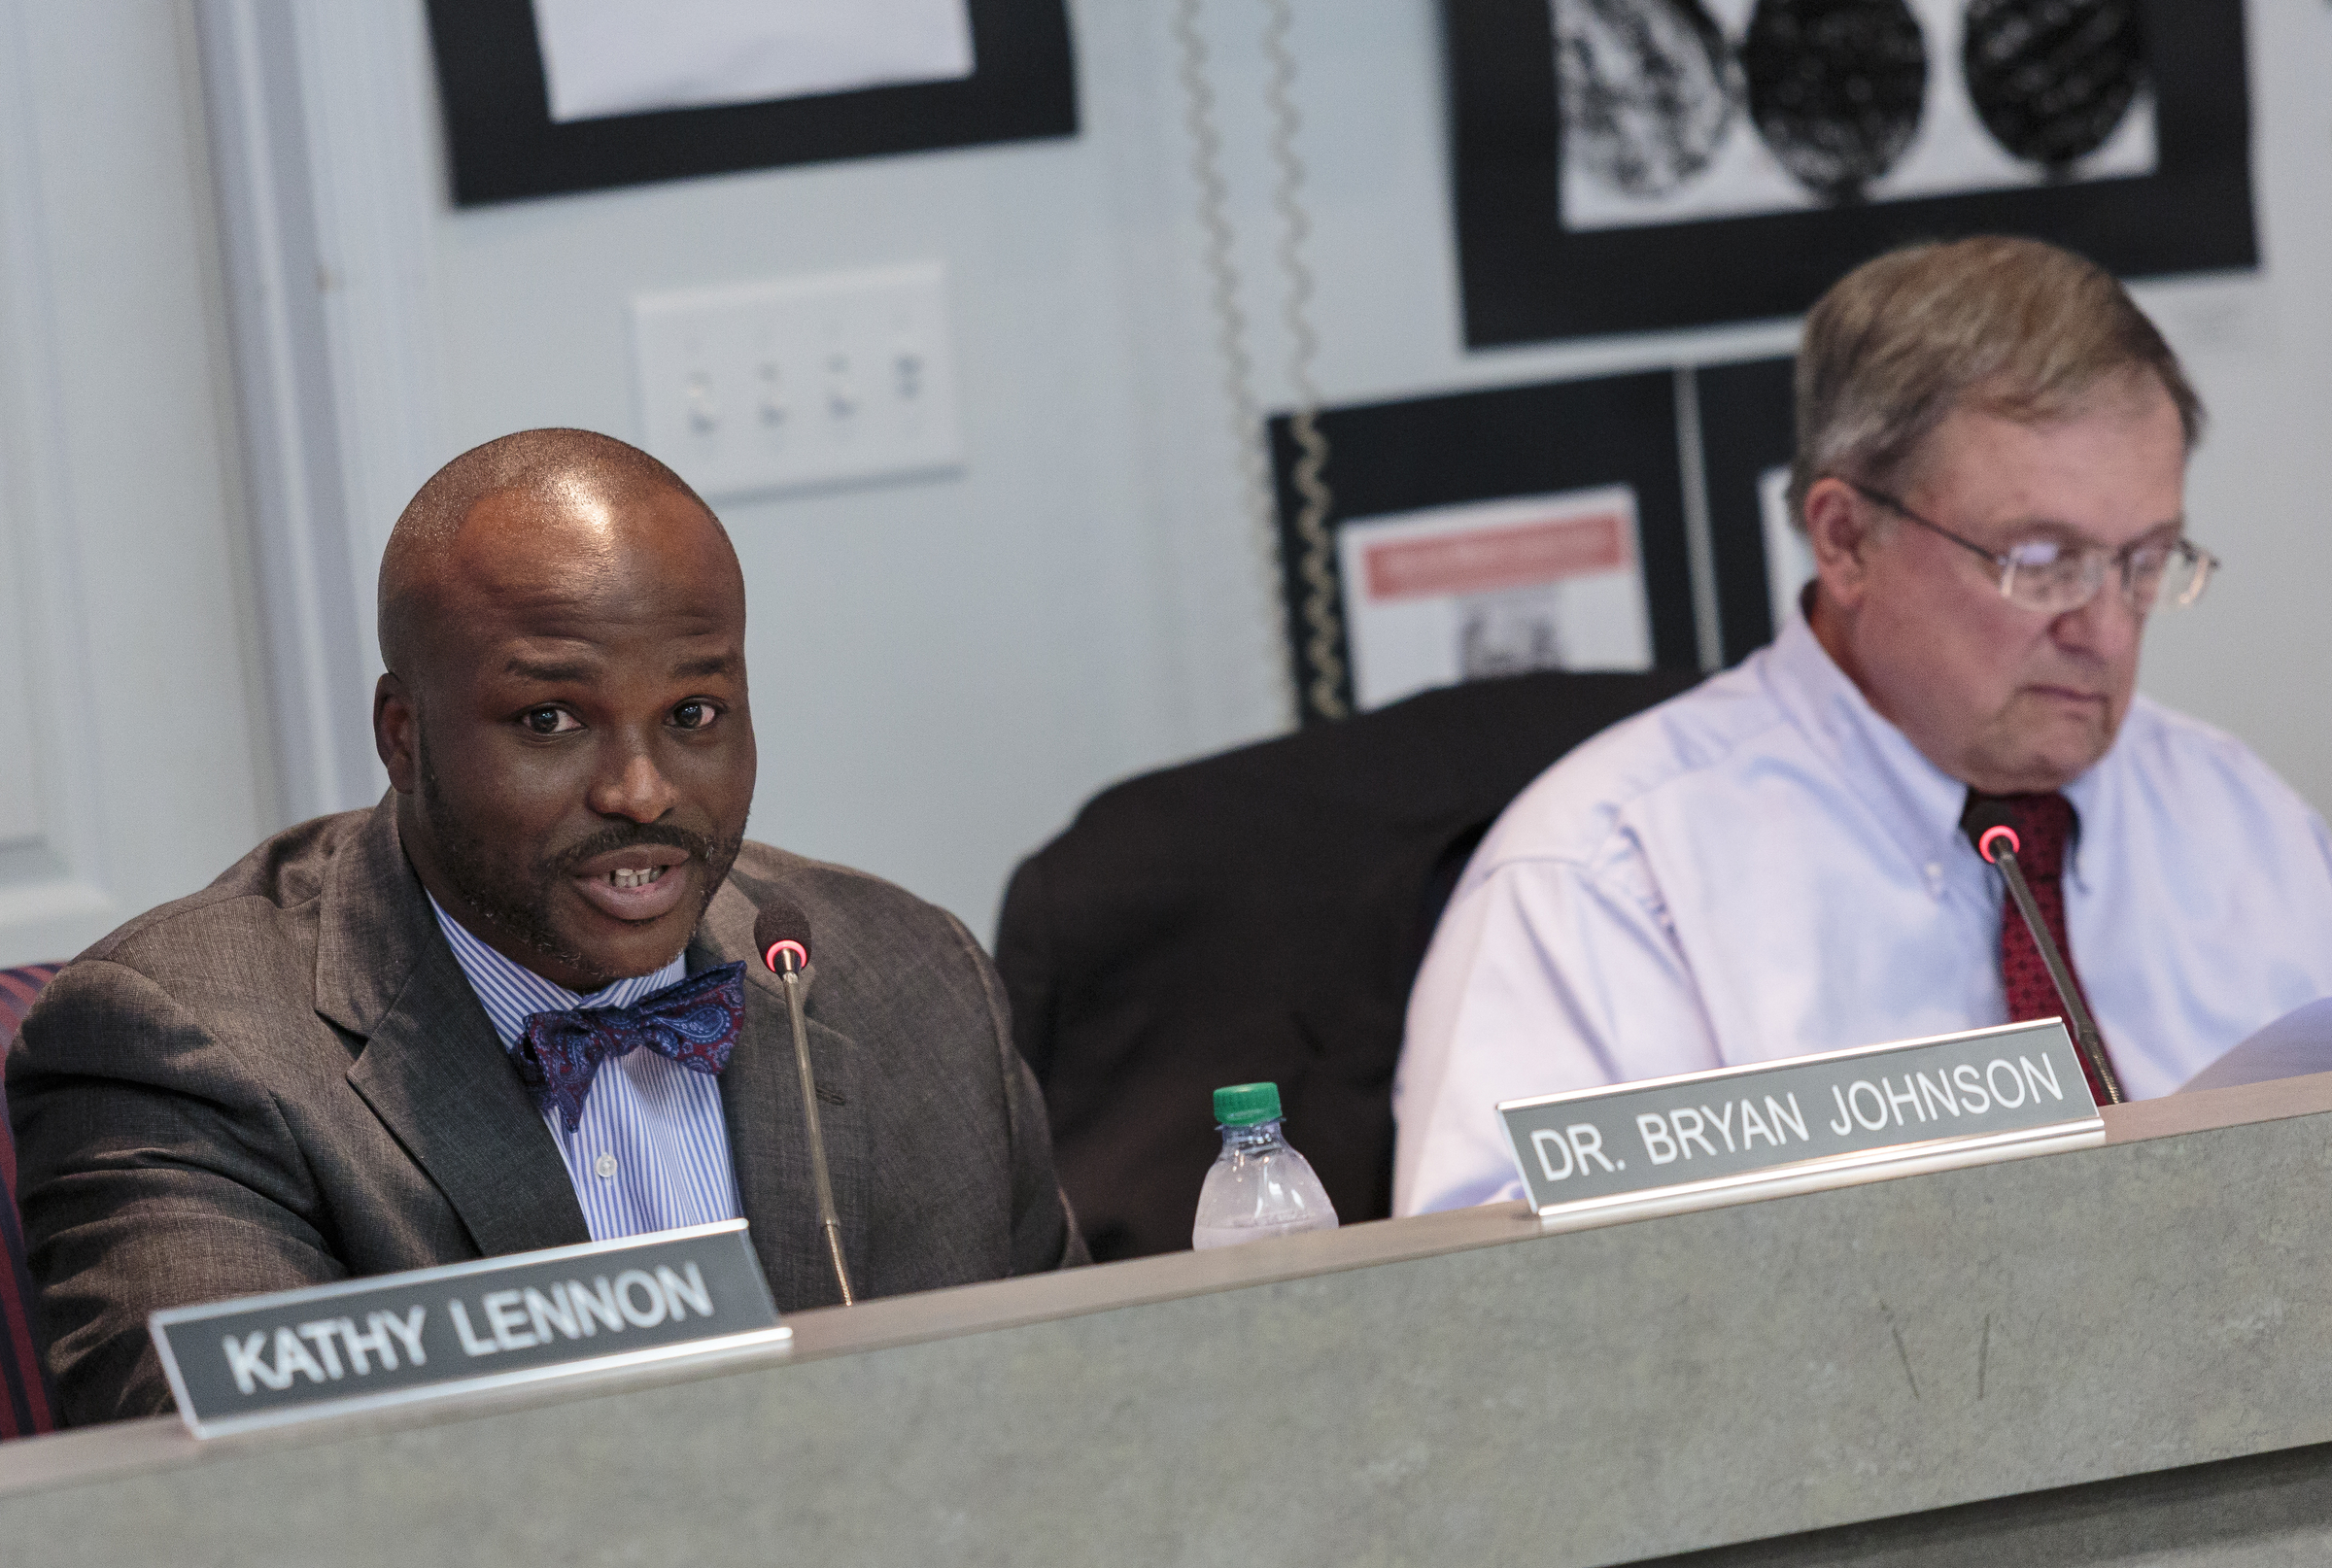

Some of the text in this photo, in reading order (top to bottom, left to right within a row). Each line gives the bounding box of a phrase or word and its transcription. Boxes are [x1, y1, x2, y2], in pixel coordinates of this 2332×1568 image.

[1530, 1051, 2065, 1182] DR. BRYAN JOHNSON
[222, 1261, 715, 1395] KATHY LENNON
